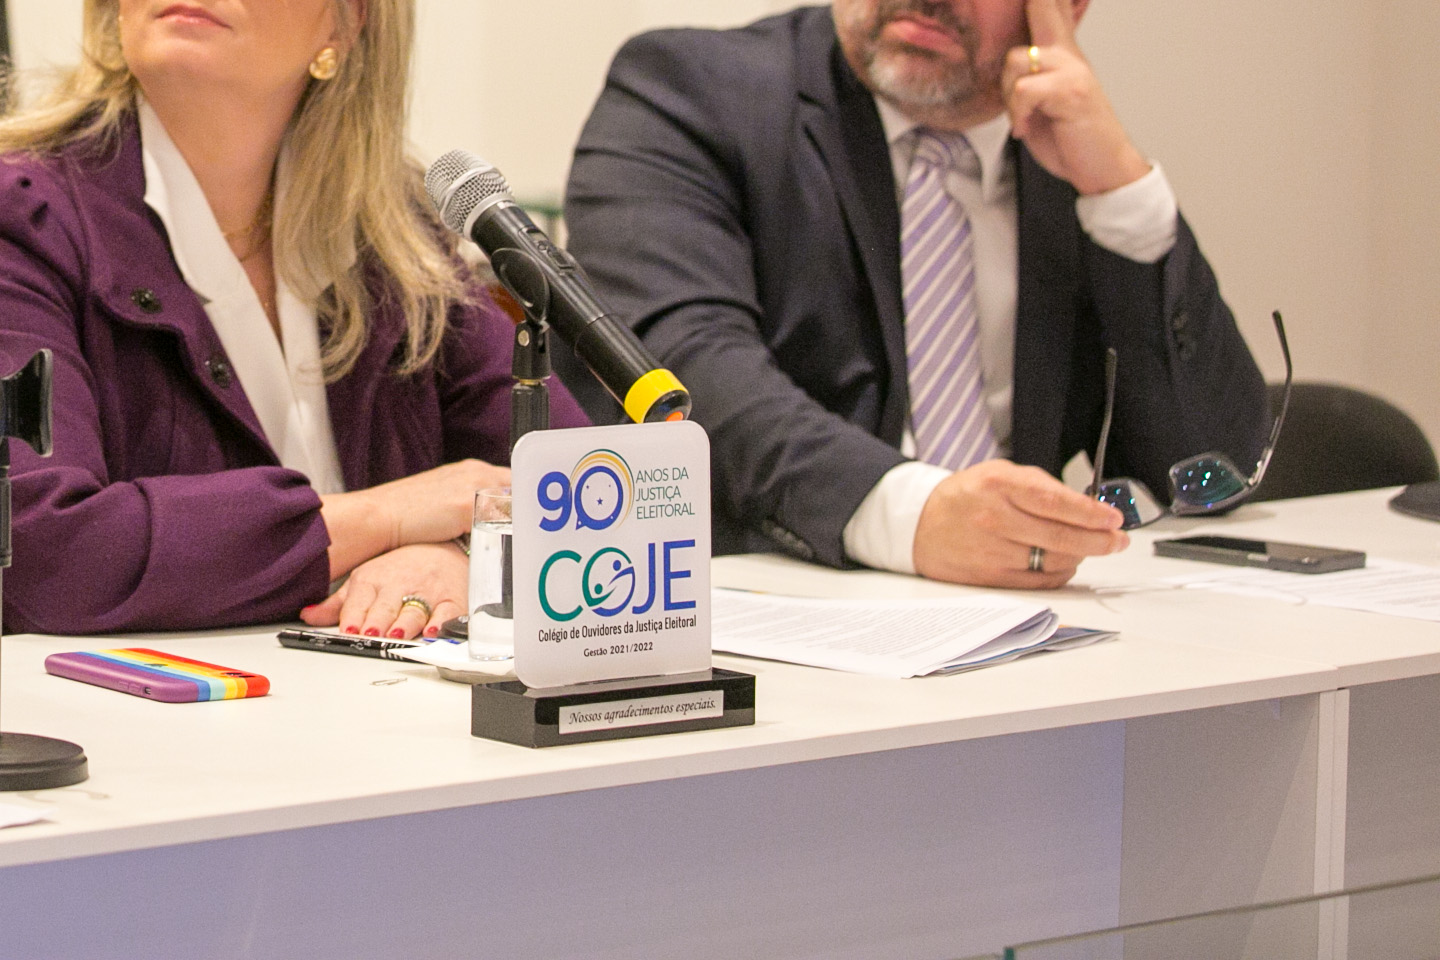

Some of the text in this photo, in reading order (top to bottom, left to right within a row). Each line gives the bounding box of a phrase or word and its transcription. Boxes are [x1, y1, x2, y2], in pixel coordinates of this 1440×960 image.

[635, 466, 689, 484] ANOS DA
[537, 465, 624, 532] 90
[636, 485, 681, 502] JUSTIÇA
[636, 502, 696, 520] ELEITORAL
[538, 539, 696, 622] COJE
[538, 614, 697, 643] Colégio de Ouvidores da Justiça Eleitoral
[583, 641, 654, 657] Gestão 2021/2022
[568, 697, 716, 725] Nossos agradecimentos especiais.
